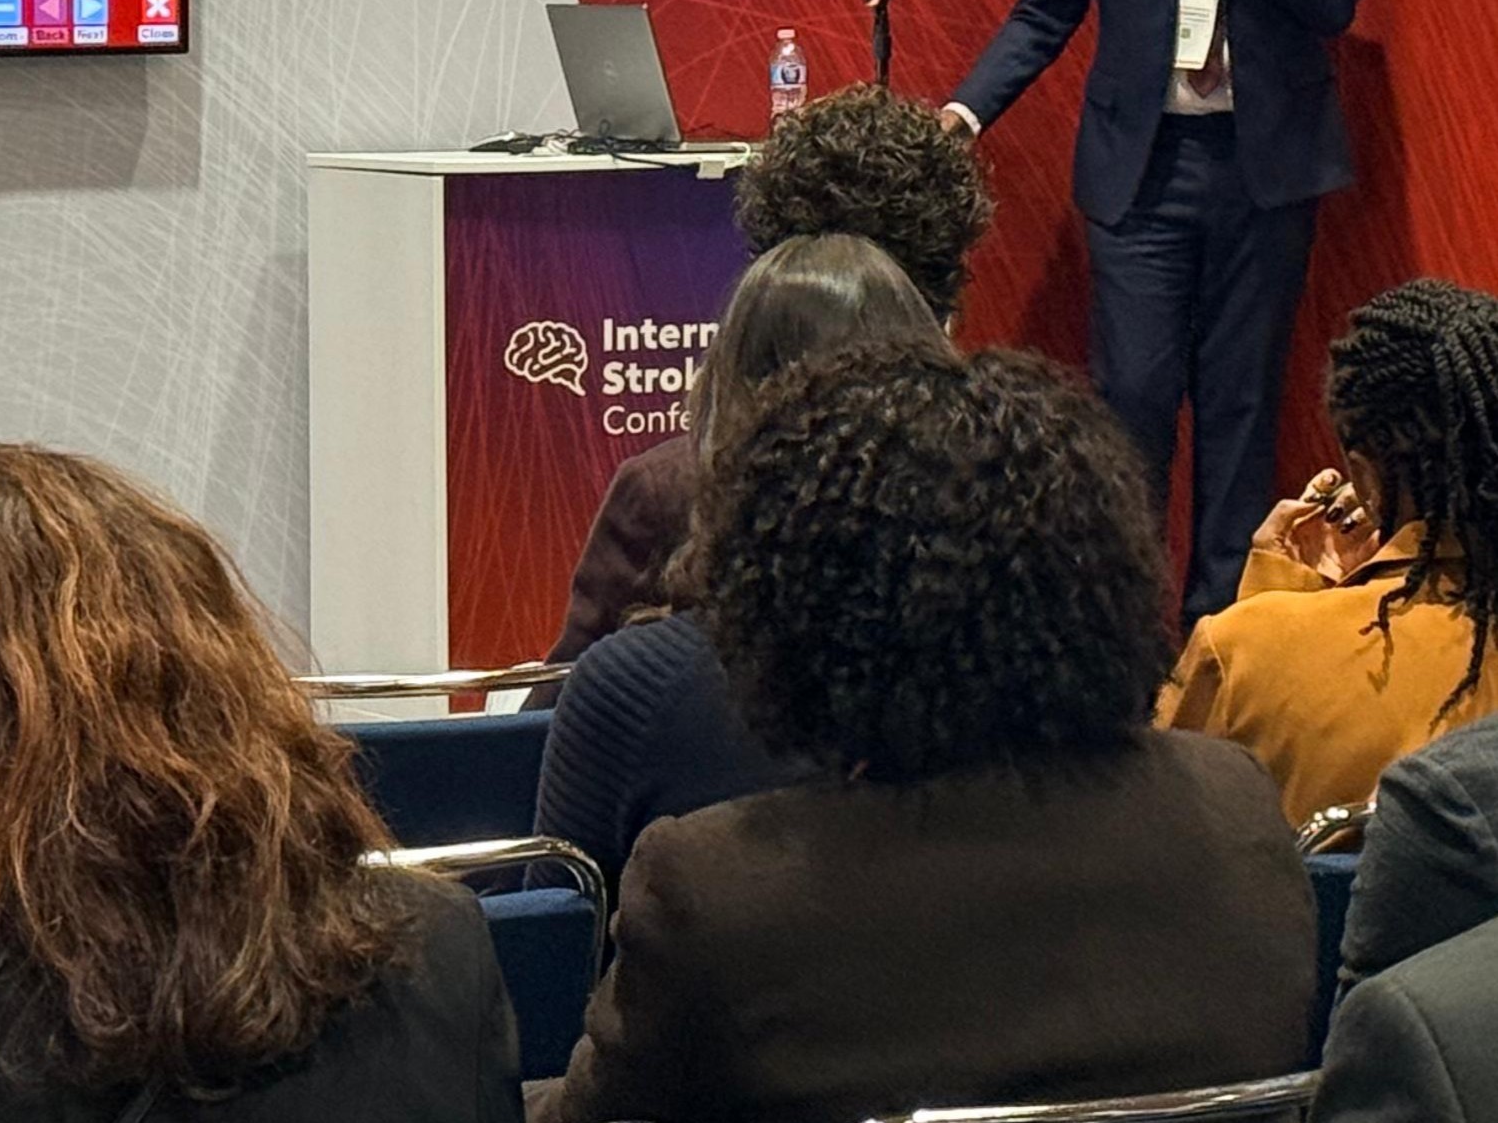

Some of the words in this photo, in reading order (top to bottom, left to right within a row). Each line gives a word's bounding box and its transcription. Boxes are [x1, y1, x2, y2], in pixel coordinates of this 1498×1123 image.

[35, 29, 65, 41] Back
[603, 318, 720, 351] Intern
[603, 401, 693, 435] Confe
